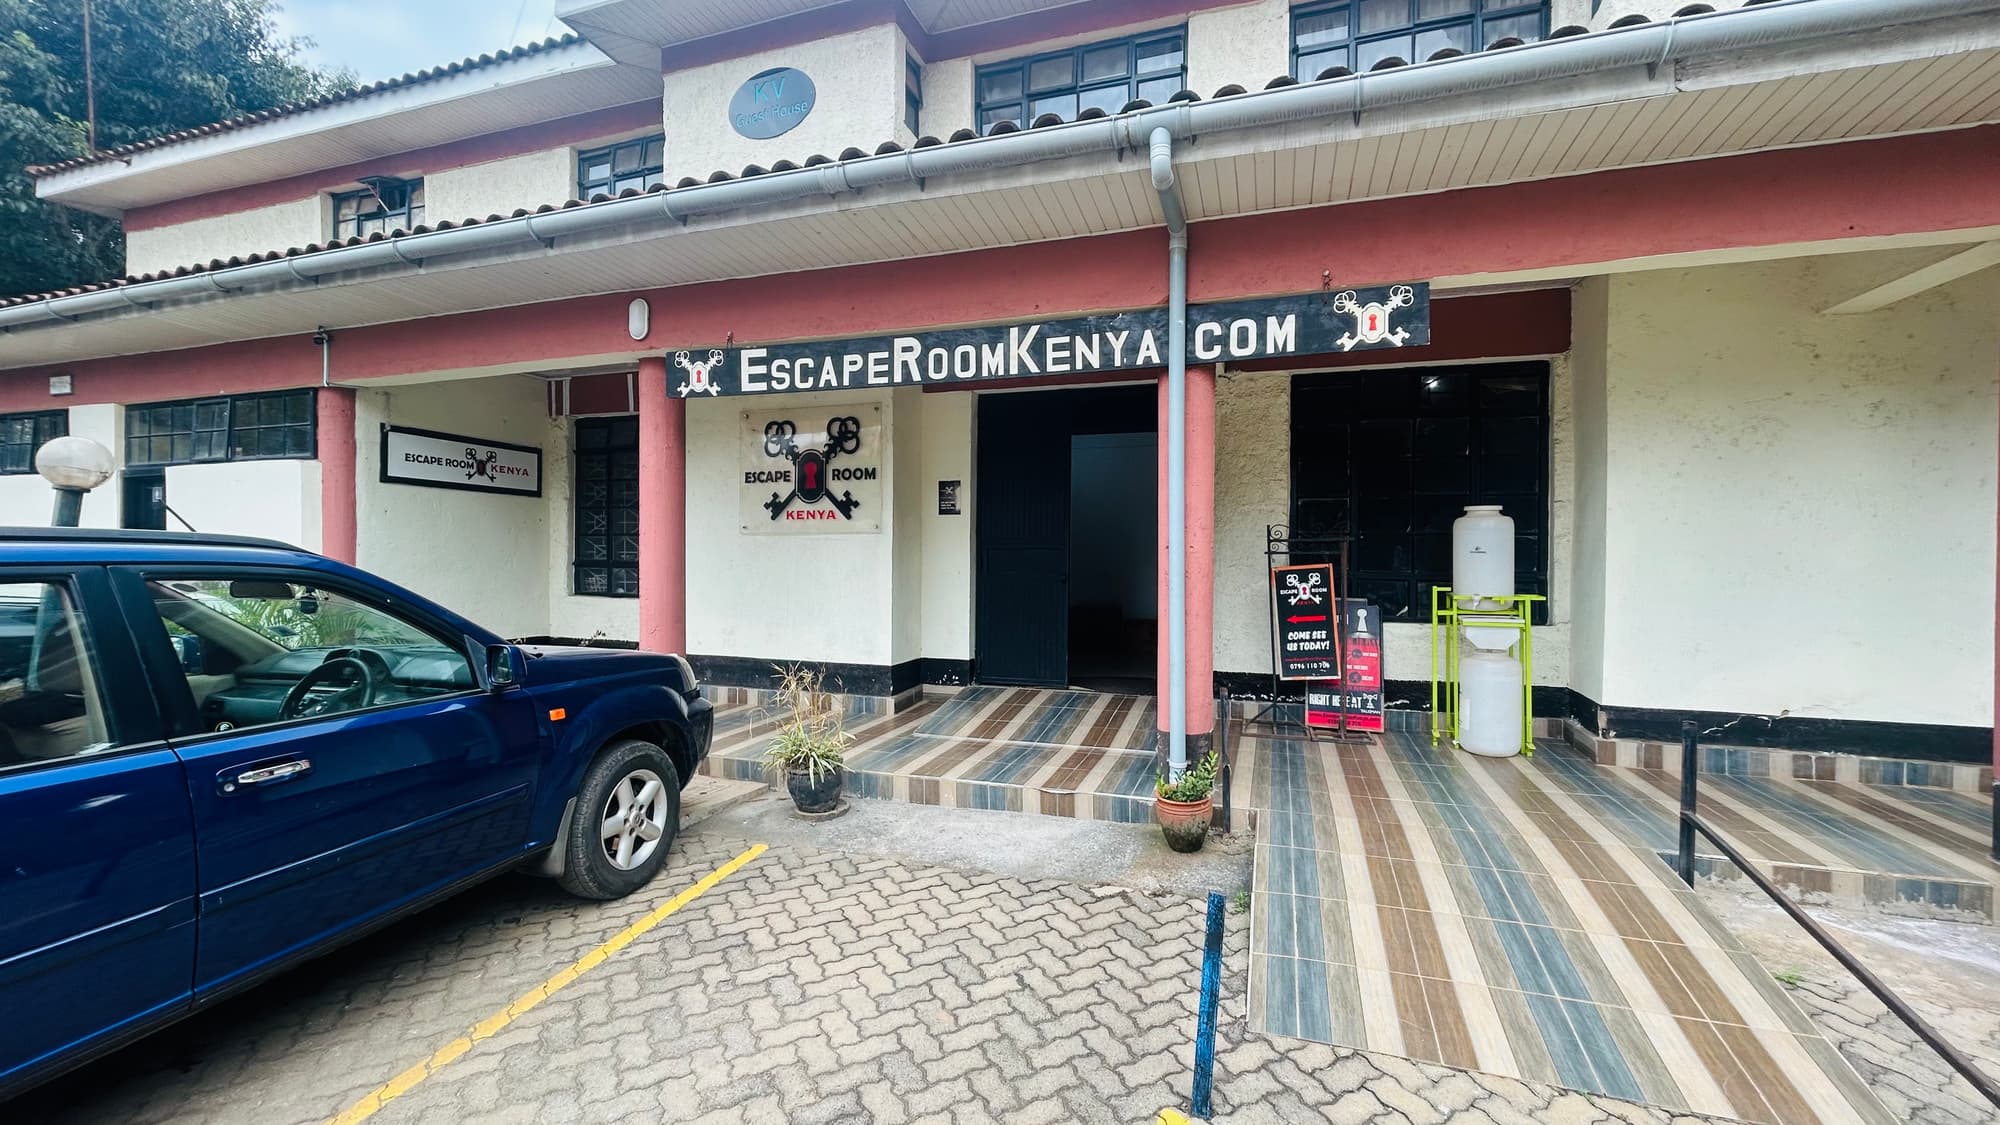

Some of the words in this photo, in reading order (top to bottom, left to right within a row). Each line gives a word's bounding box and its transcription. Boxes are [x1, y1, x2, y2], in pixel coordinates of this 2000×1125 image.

[754, 76, 785, 104] KV
[736, 108, 768, 128] Guest
[771, 102, 808, 119] House
[404, 452, 443, 466] ESCAPE
[445, 457, 475, 470] ROOM
[491, 463, 529, 477] KENYA
[744, 470, 791, 484] ESCAPE
[831, 467, 877, 481] ROOM
[786, 510, 837, 520] KENYA
[1287, 631, 1311, 641] COME
[1312, 630, 1327, 640] SEE
[1286, 642, 1298, 651] US
[1299, 640, 1330, 651] TODAY!
[1309, 693, 1331, 706] RIGHT
[1332, 695, 1350, 708] HEE
[1351, 696, 1362, 709] AT
